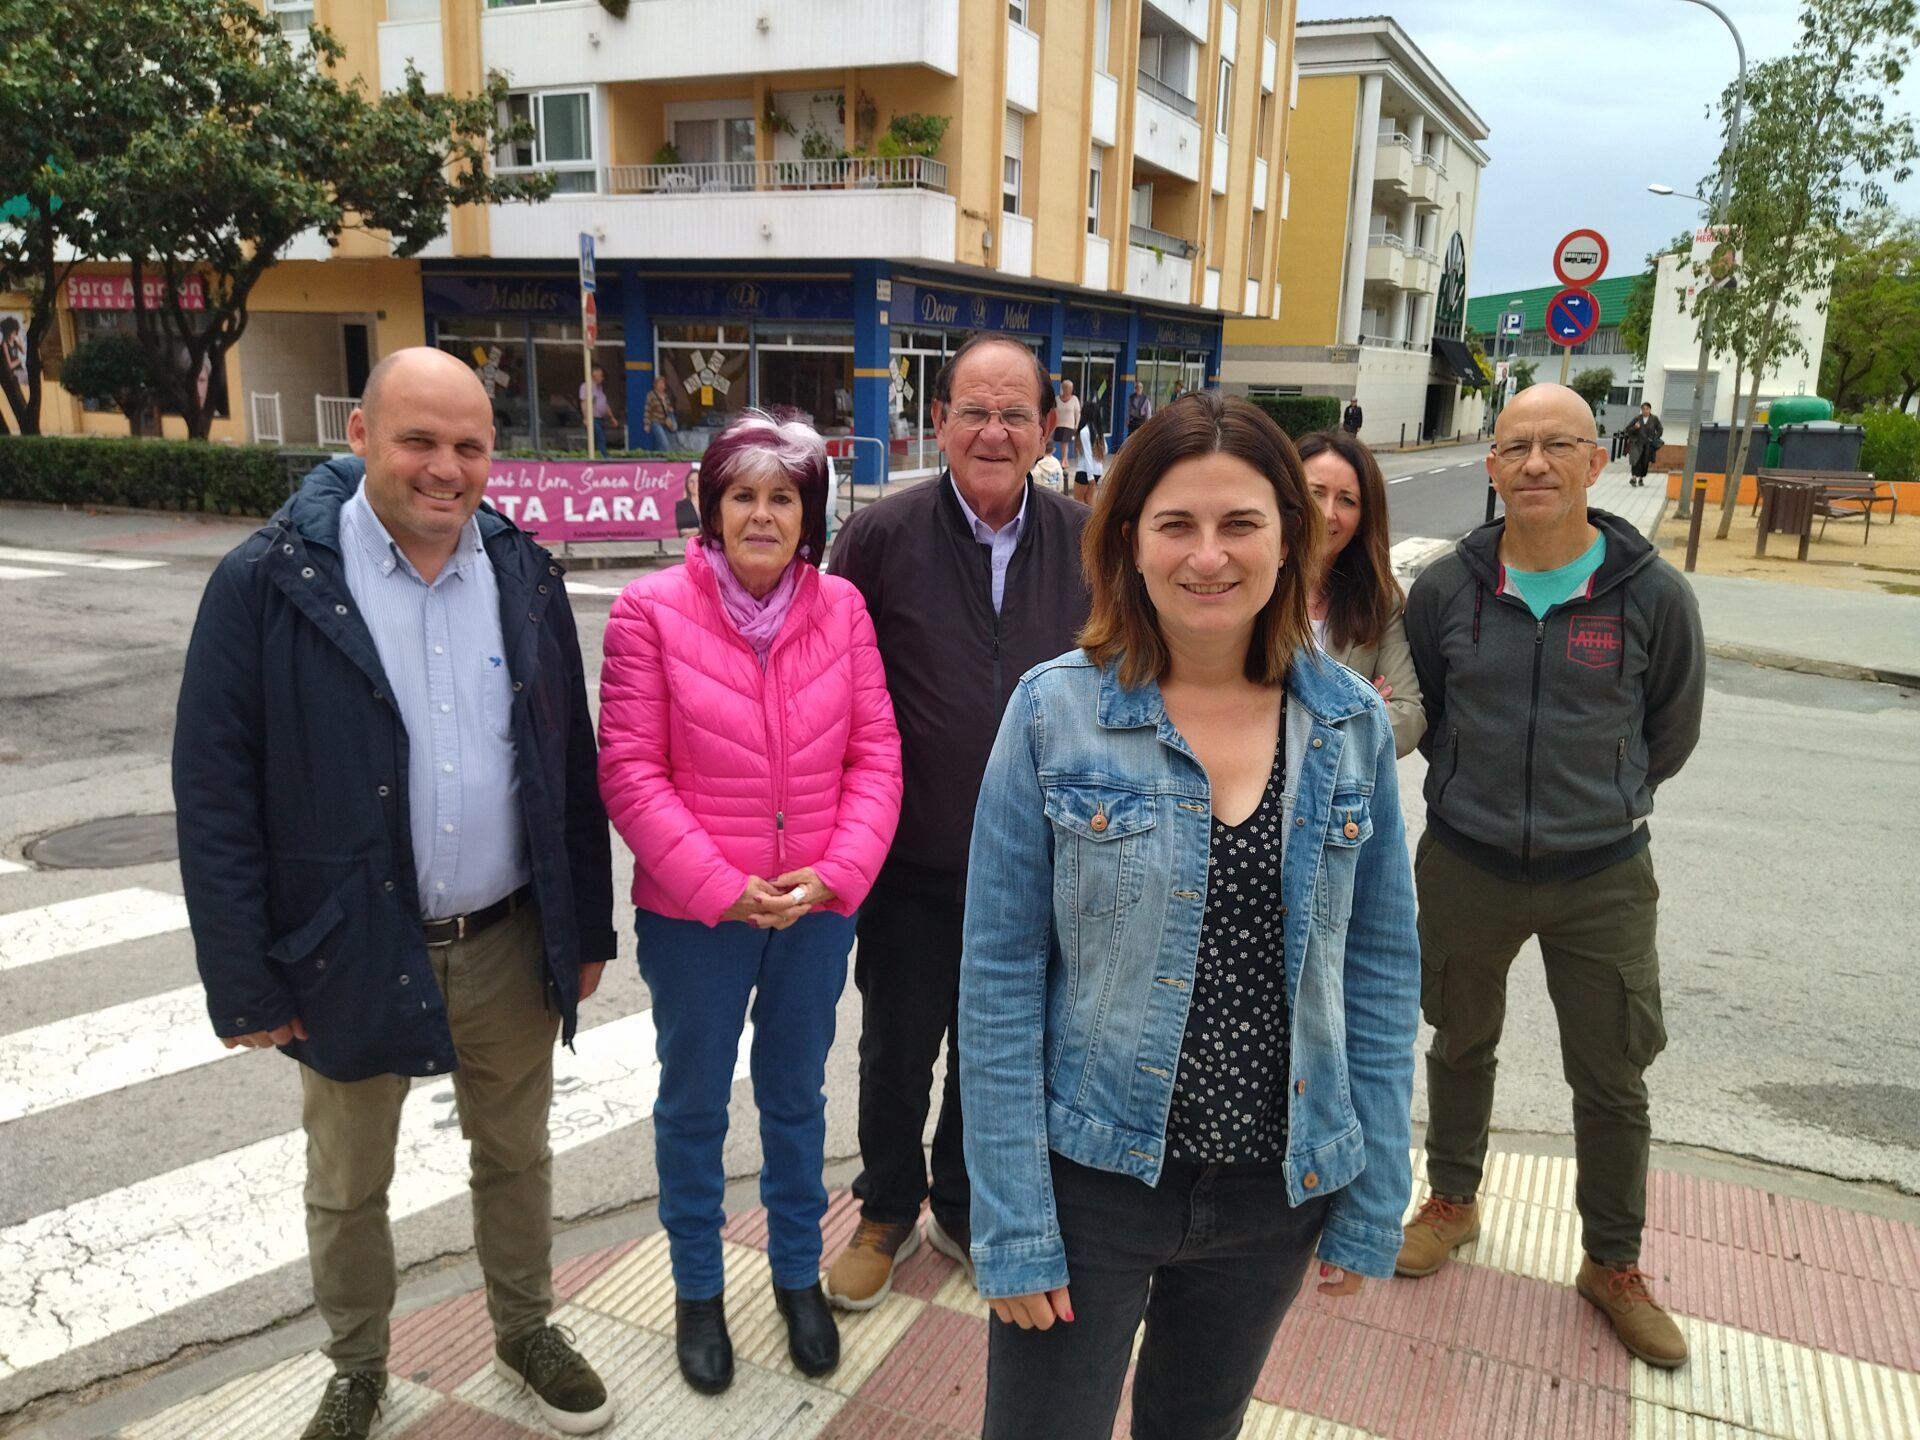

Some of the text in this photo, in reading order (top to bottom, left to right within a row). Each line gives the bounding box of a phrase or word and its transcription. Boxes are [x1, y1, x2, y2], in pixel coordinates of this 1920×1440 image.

[68, 277, 202, 297] Sara Aaron
[485, 281, 559, 310] Mobles
[921, 293, 959, 323] Decor
[1000, 302, 1033, 330] Mobel
[1507, 314, 1520, 329] P
[519, 468, 533, 488] la
[634, 466, 674, 492] Lloret
[563, 496, 661, 522] LARA
[1575, 630, 1617, 650] ATHL
